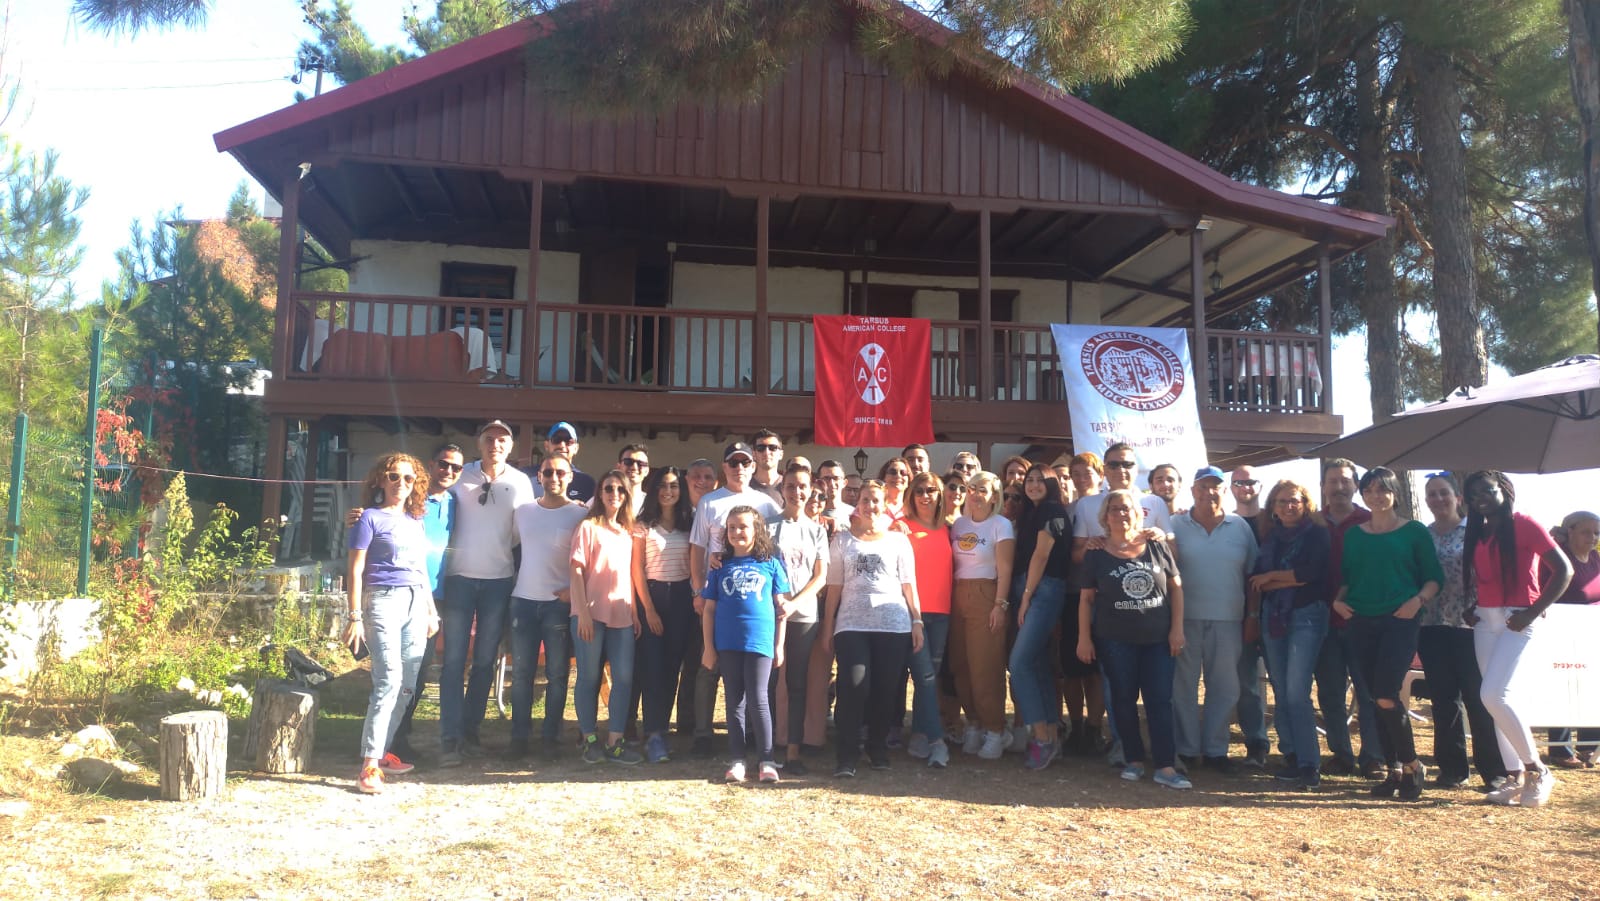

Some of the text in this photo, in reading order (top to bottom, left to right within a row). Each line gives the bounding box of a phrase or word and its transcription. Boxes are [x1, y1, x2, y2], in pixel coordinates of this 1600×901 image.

[1083, 332, 1183, 386] TARSUS AMERICAN COLLEGE
[1089, 422, 1121, 433] TARSU
